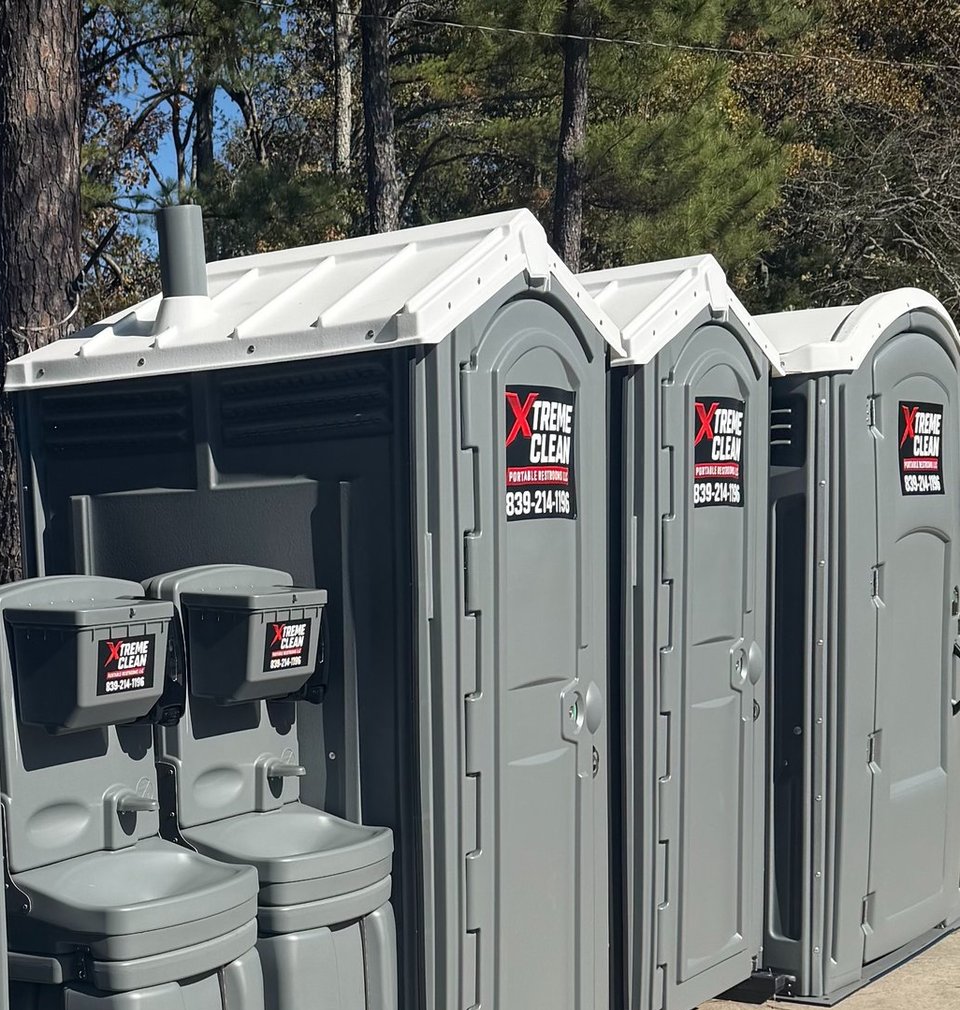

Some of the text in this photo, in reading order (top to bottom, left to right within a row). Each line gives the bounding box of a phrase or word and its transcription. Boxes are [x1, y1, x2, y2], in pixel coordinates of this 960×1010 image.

[504, 392, 573, 448] XTREME
[694, 402, 743, 448] XTREME
[900, 405, 941, 449] XTREME
[530, 433, 571, 465] CLEAN
[711, 435, 741, 462] CLEAN
[913, 435, 940, 457] CLEAN
[506, 490, 570, 516] 839-214-1196
[693, 482, 741, 504] 839-214-1196
[270, 623, 306, 647] XTREME
[281, 635, 305, 649] CLEAN
[104, 640, 149, 667] XTREME
[117, 654, 147, 670] CLEAN
[105, 676, 145, 692] 839-214-1196
